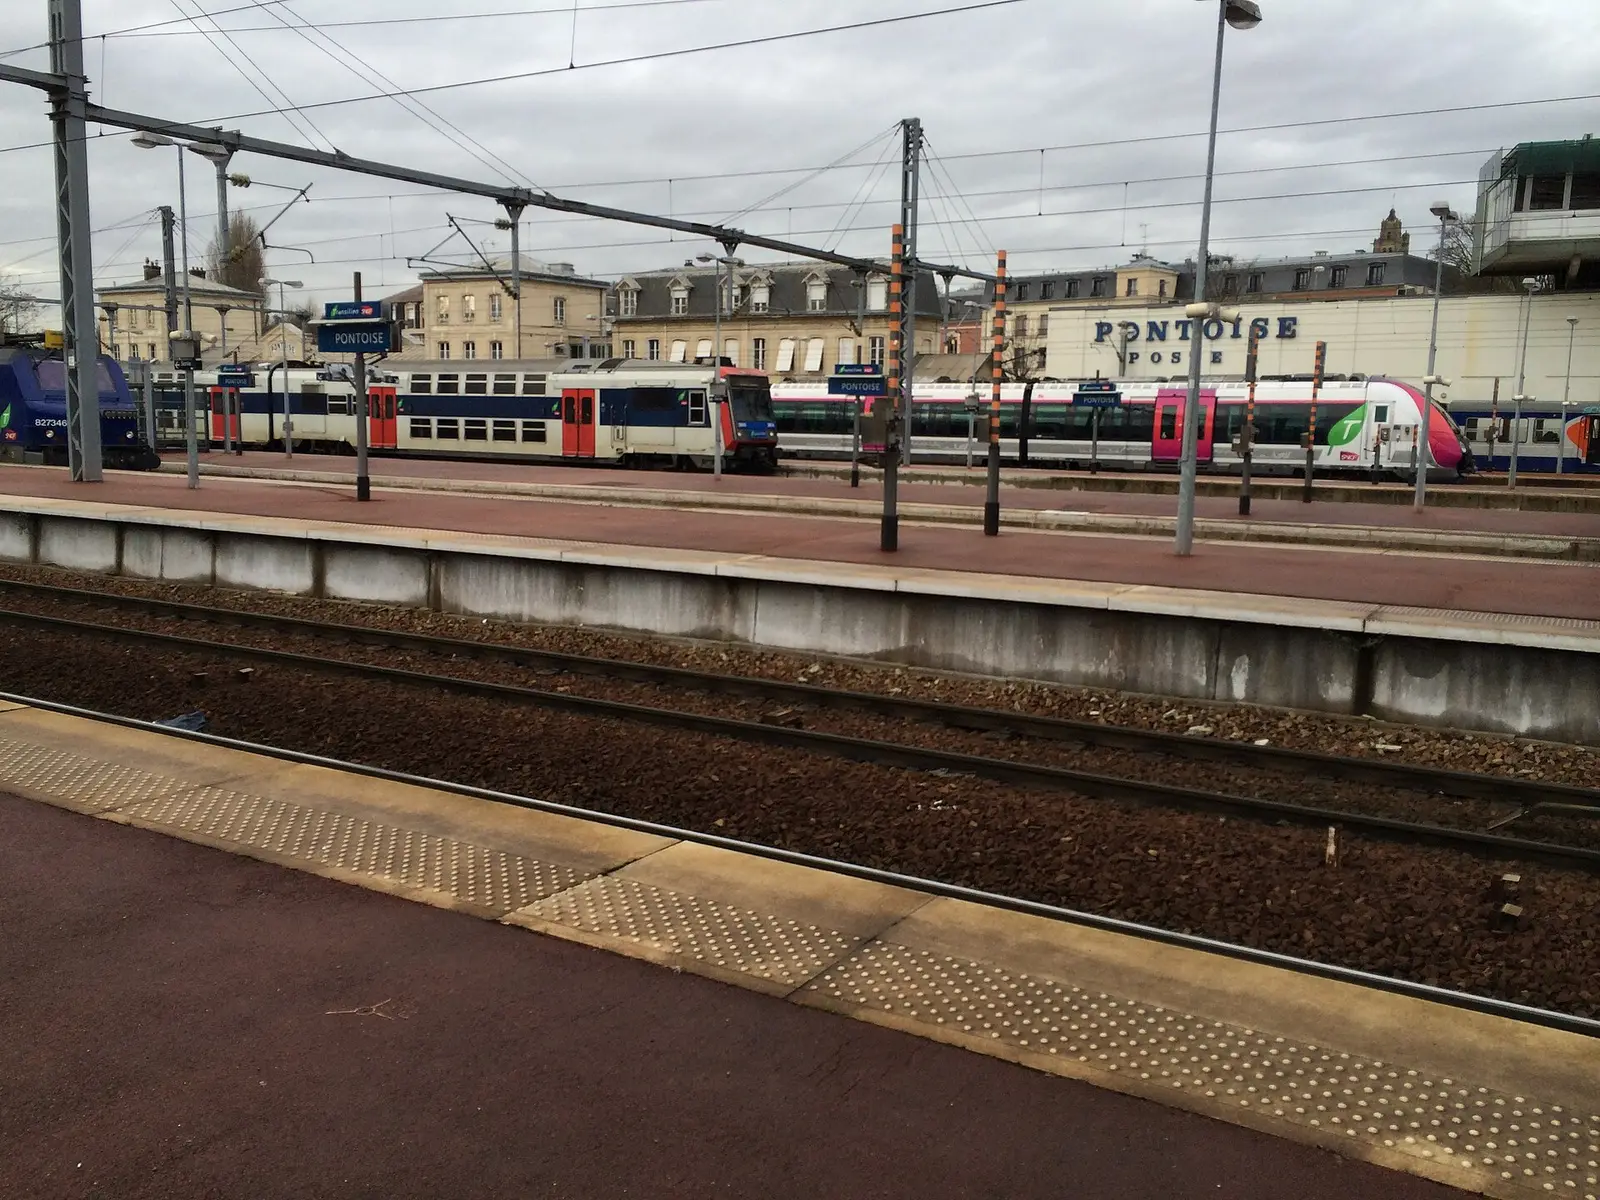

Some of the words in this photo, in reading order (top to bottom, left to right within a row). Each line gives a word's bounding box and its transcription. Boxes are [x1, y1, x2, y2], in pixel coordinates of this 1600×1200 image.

[1094, 316, 1298, 342] PONTOISE
[335, 333, 384, 344] PONTOISE
[1128, 351, 1223, 364] POSE
[841, 383, 880, 391] PONTOISE
[35, 419, 68, 427] 827346
